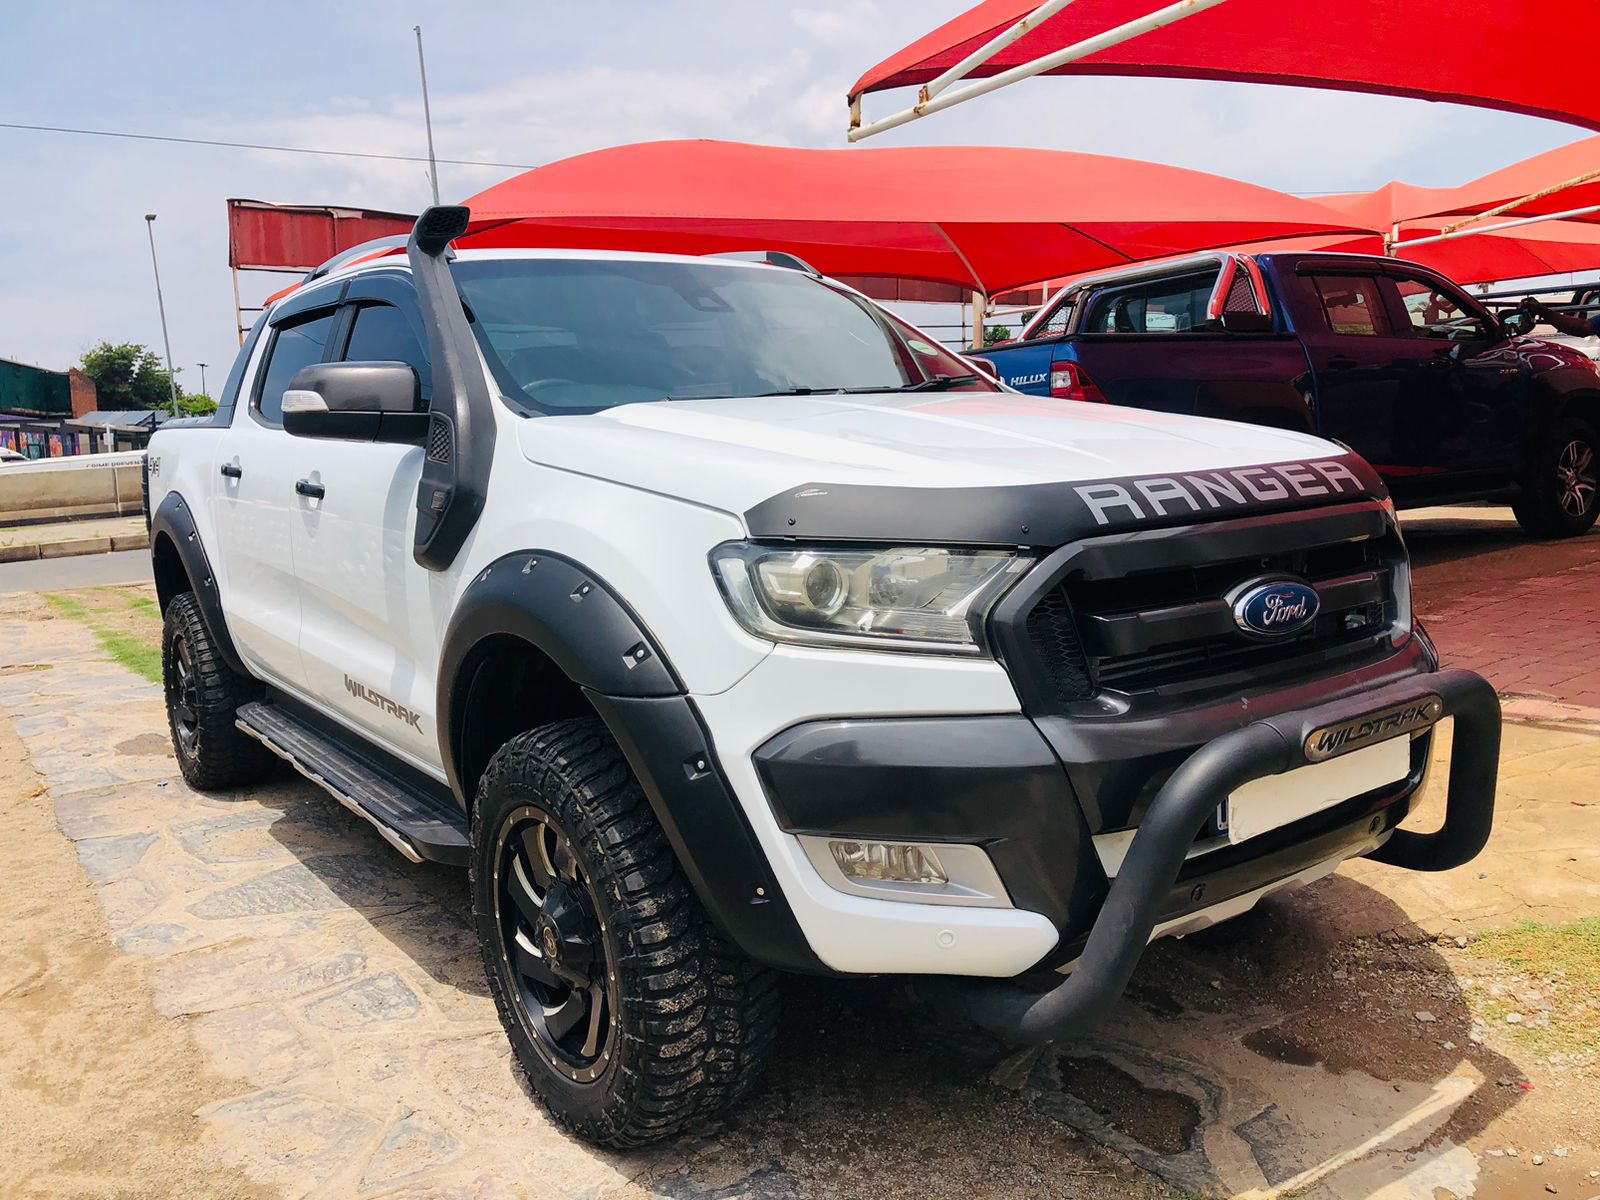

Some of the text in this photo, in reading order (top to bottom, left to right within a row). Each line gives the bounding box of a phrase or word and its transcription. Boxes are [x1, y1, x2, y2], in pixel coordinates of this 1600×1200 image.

[1010, 373, 1047, 386] HILUX
[1073, 460, 1365, 525] RANGER
[1262, 592, 1308, 626] Ford
[344, 673, 424, 735] WILDTRAK
[1316, 701, 1430, 752] WILDTRAK
